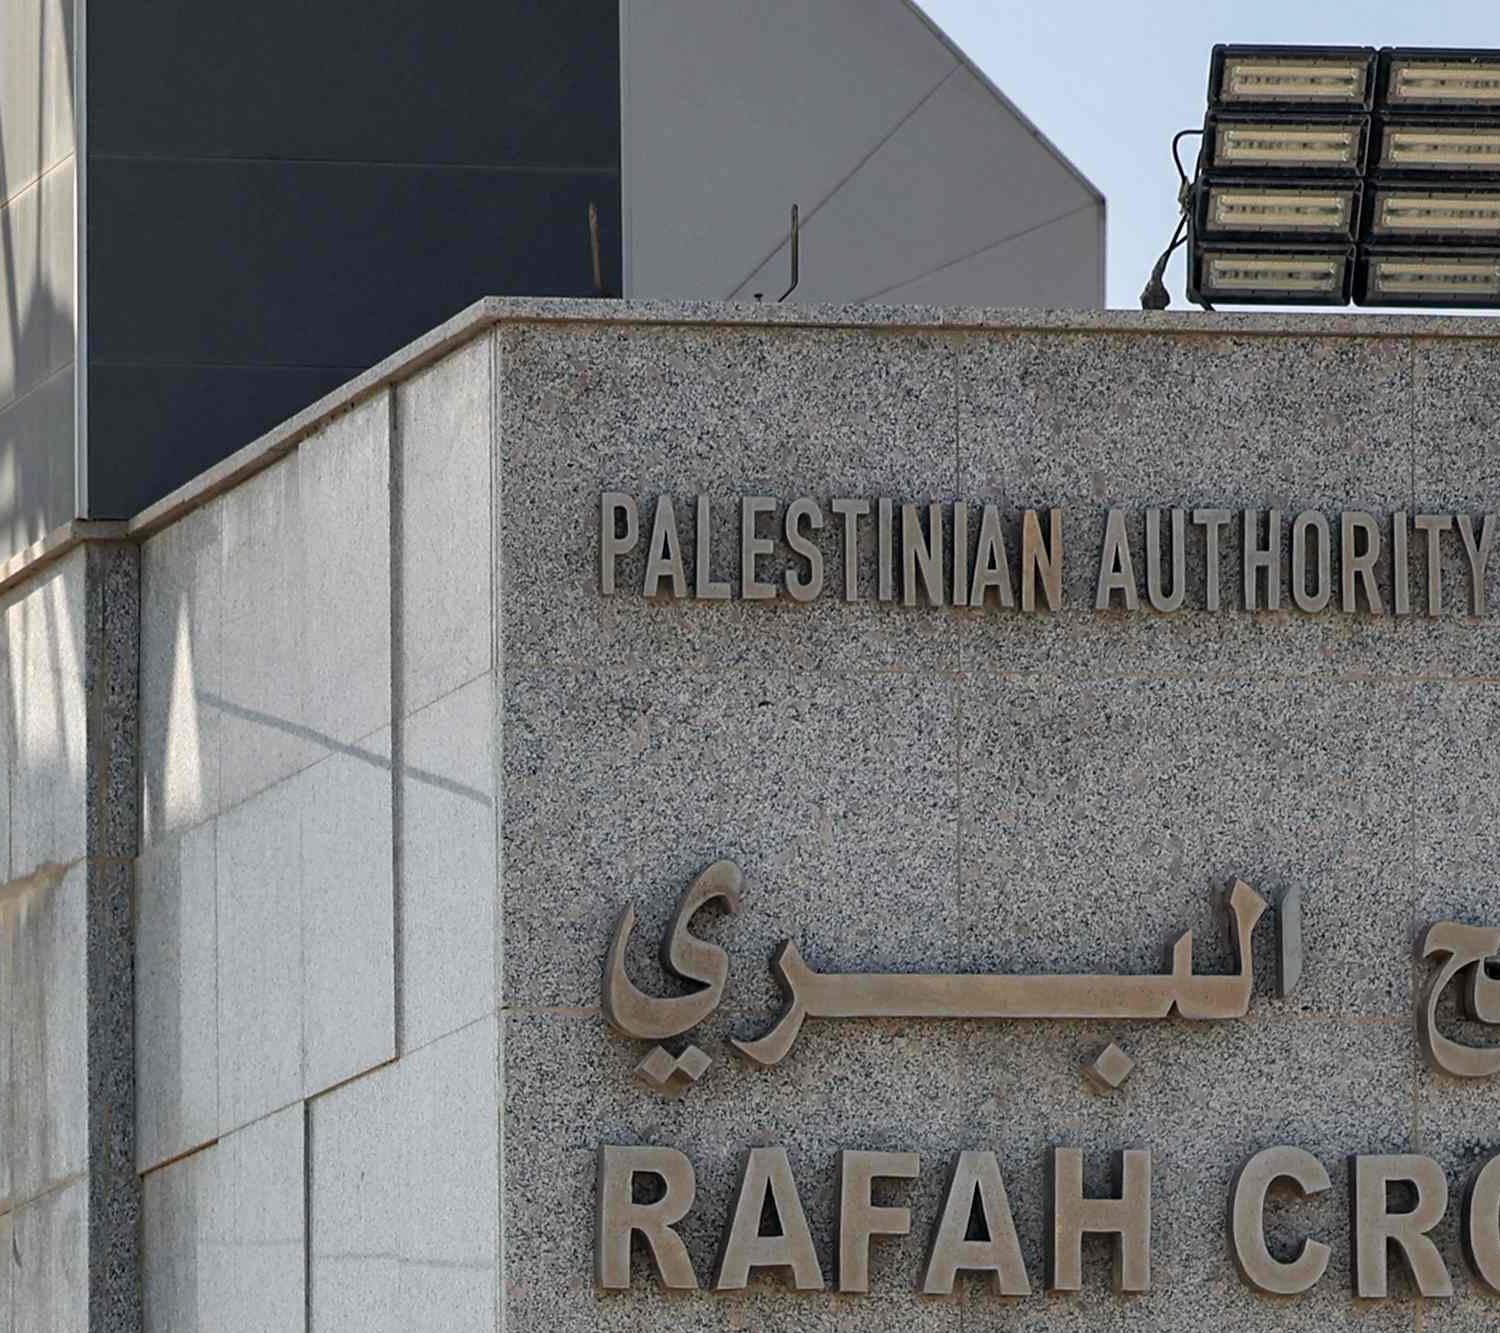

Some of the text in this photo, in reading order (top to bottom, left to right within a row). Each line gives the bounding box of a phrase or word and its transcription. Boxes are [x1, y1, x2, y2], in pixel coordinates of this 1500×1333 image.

[601, 489, 1498, 617] PALESTINIAN AUTHORITY
[602, 858, 1303, 1098] البري
[595, 1143, 1153, 1298] RAFAH
